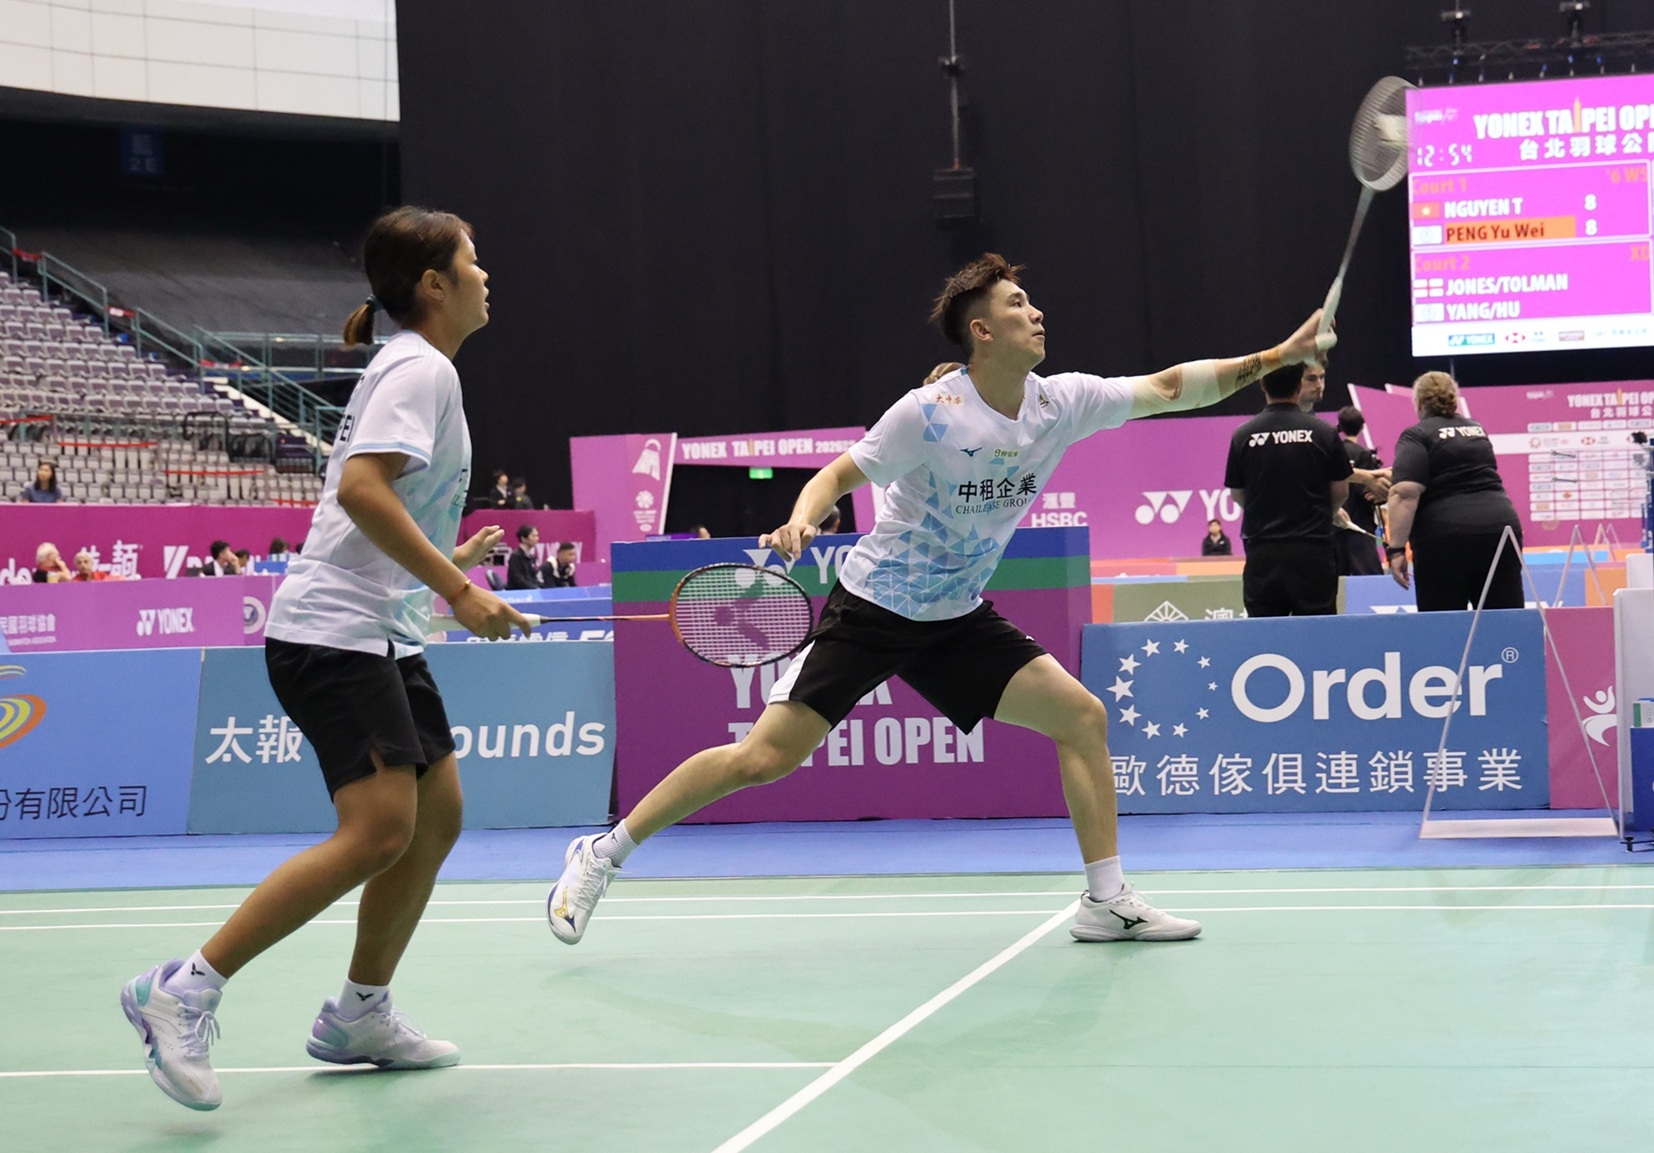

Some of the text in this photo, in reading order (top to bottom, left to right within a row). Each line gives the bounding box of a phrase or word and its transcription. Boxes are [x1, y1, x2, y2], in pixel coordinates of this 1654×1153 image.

[1474, 112, 1544, 139] YONEX
[1619, 104, 1654, 131] OP
[1417, 144, 1472, 167] 12:54
[1520, 133, 1654, 160] 台北羽球公
[1412, 179, 1454, 194] Court
[1444, 194, 1596, 218] NGUYEN T 8
[1446, 218, 1597, 242] PENG Yu Wei 8
[1415, 257, 1456, 273] Court
[1460, 255, 1470, 270] 2
[1446, 274, 1568, 296] JONES/TOLMAN
[1446, 301, 1521, 321] YANG/HU
[682, 442, 728, 460] YONEX
[778, 438, 813, 455] OPEN
[1272, 430, 1313, 444] YONEX
[958, 473, 1037, 503] 中租企業
[955, 497, 1030, 515] CHAILEASE GRO
[1031, 511, 1088, 528] HSBC
[157, 607, 194, 635] YONEX
[1231, 652, 1502, 722] Order
[206, 715, 302, 764] 太報
[450, 711, 606, 760] ounds
[874, 716, 984, 765] OPEN
[1109, 748, 1523, 796] 歐德傢俱連鎖事業
